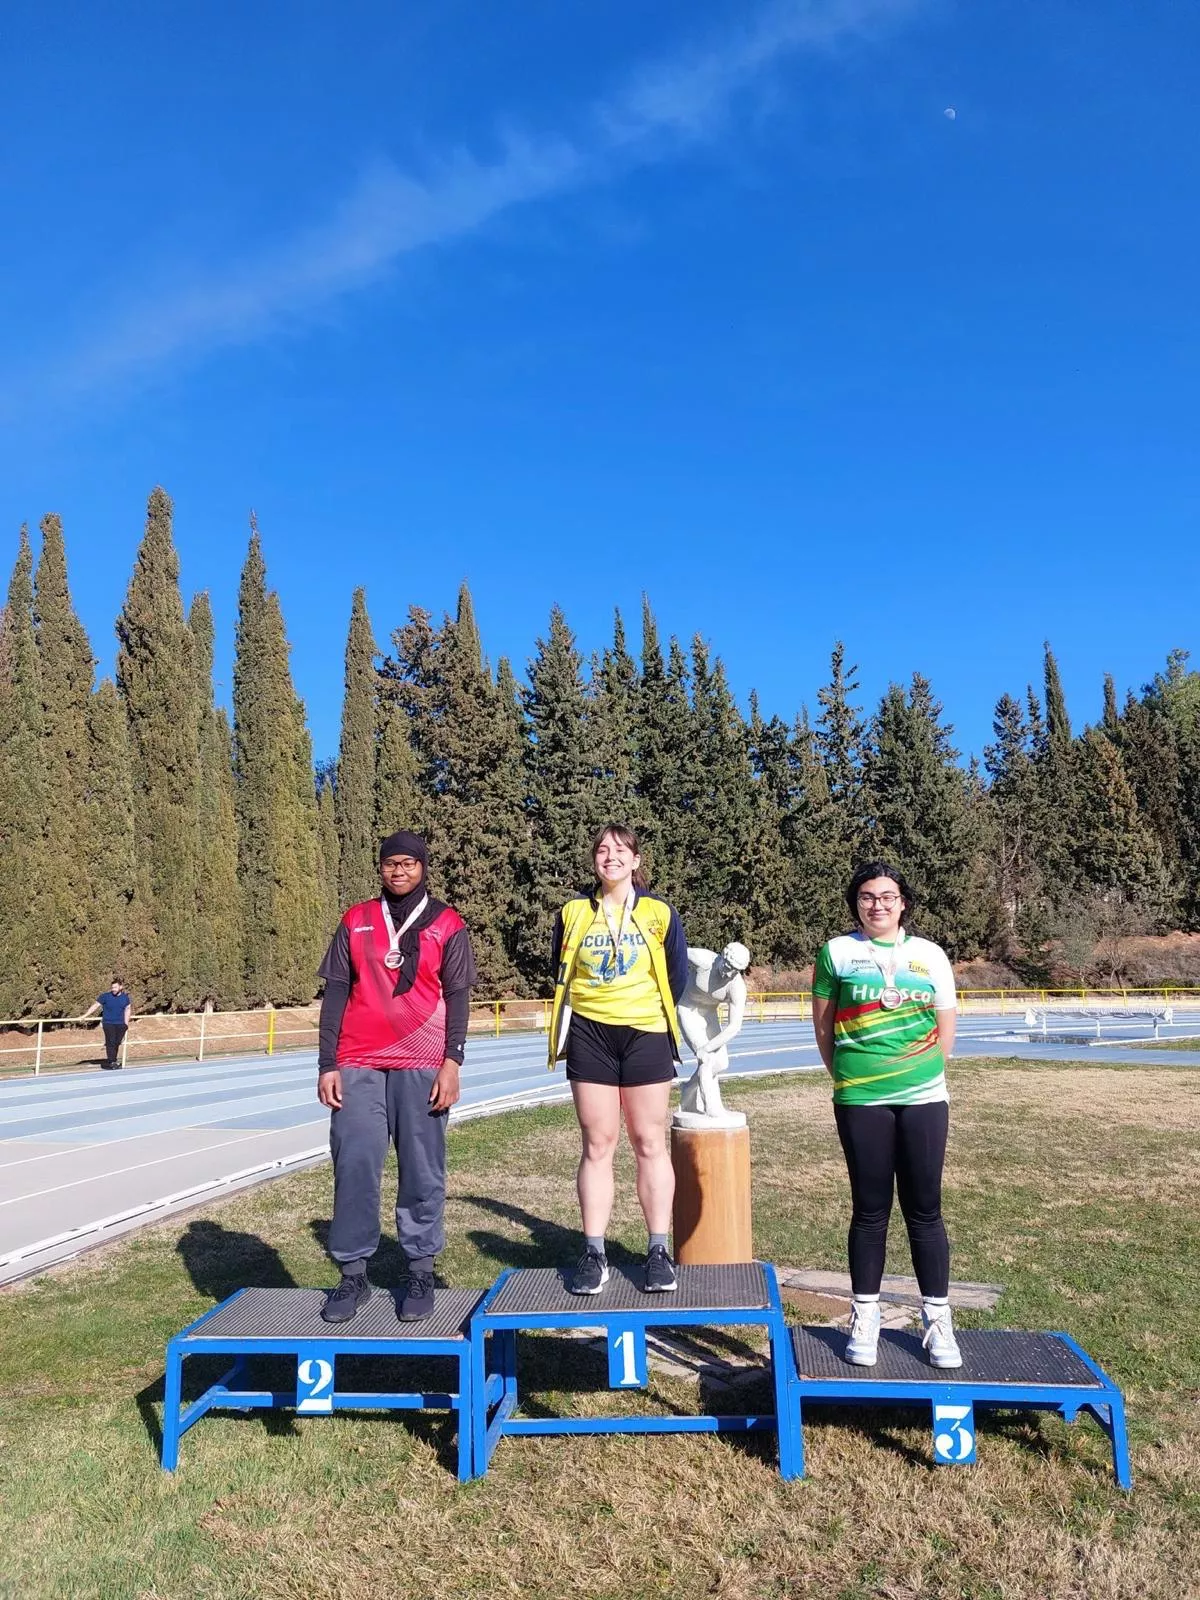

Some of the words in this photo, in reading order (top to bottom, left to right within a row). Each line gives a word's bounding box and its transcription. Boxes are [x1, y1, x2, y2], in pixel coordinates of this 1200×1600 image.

[852, 984, 932, 1004] Husca
[613, 1331, 641, 1385] 1
[297, 1359, 333, 1411] 2
[935, 1405, 973, 1460] 3
